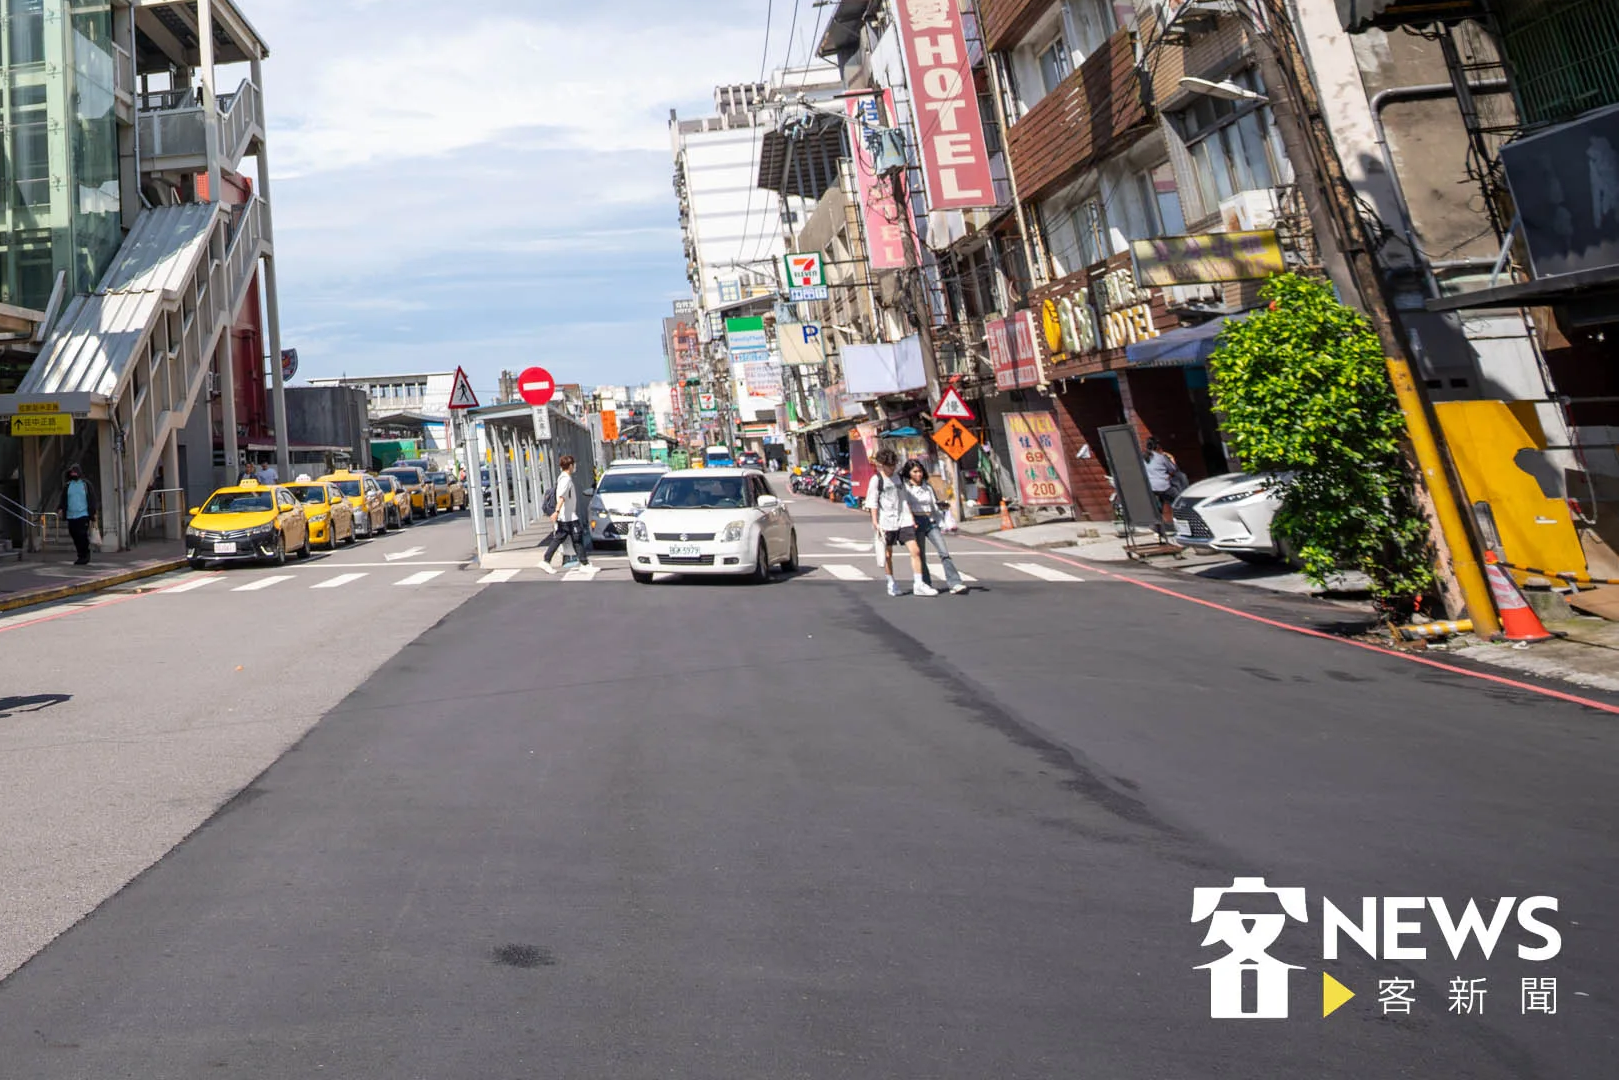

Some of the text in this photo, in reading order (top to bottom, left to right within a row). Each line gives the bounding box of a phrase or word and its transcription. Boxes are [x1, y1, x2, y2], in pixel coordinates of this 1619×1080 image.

[913, 33, 982, 201] HOTEL
[802, 325, 819, 344] P
[945, 400, 960, 413] 慢
[1032, 482, 1057, 496] 200
